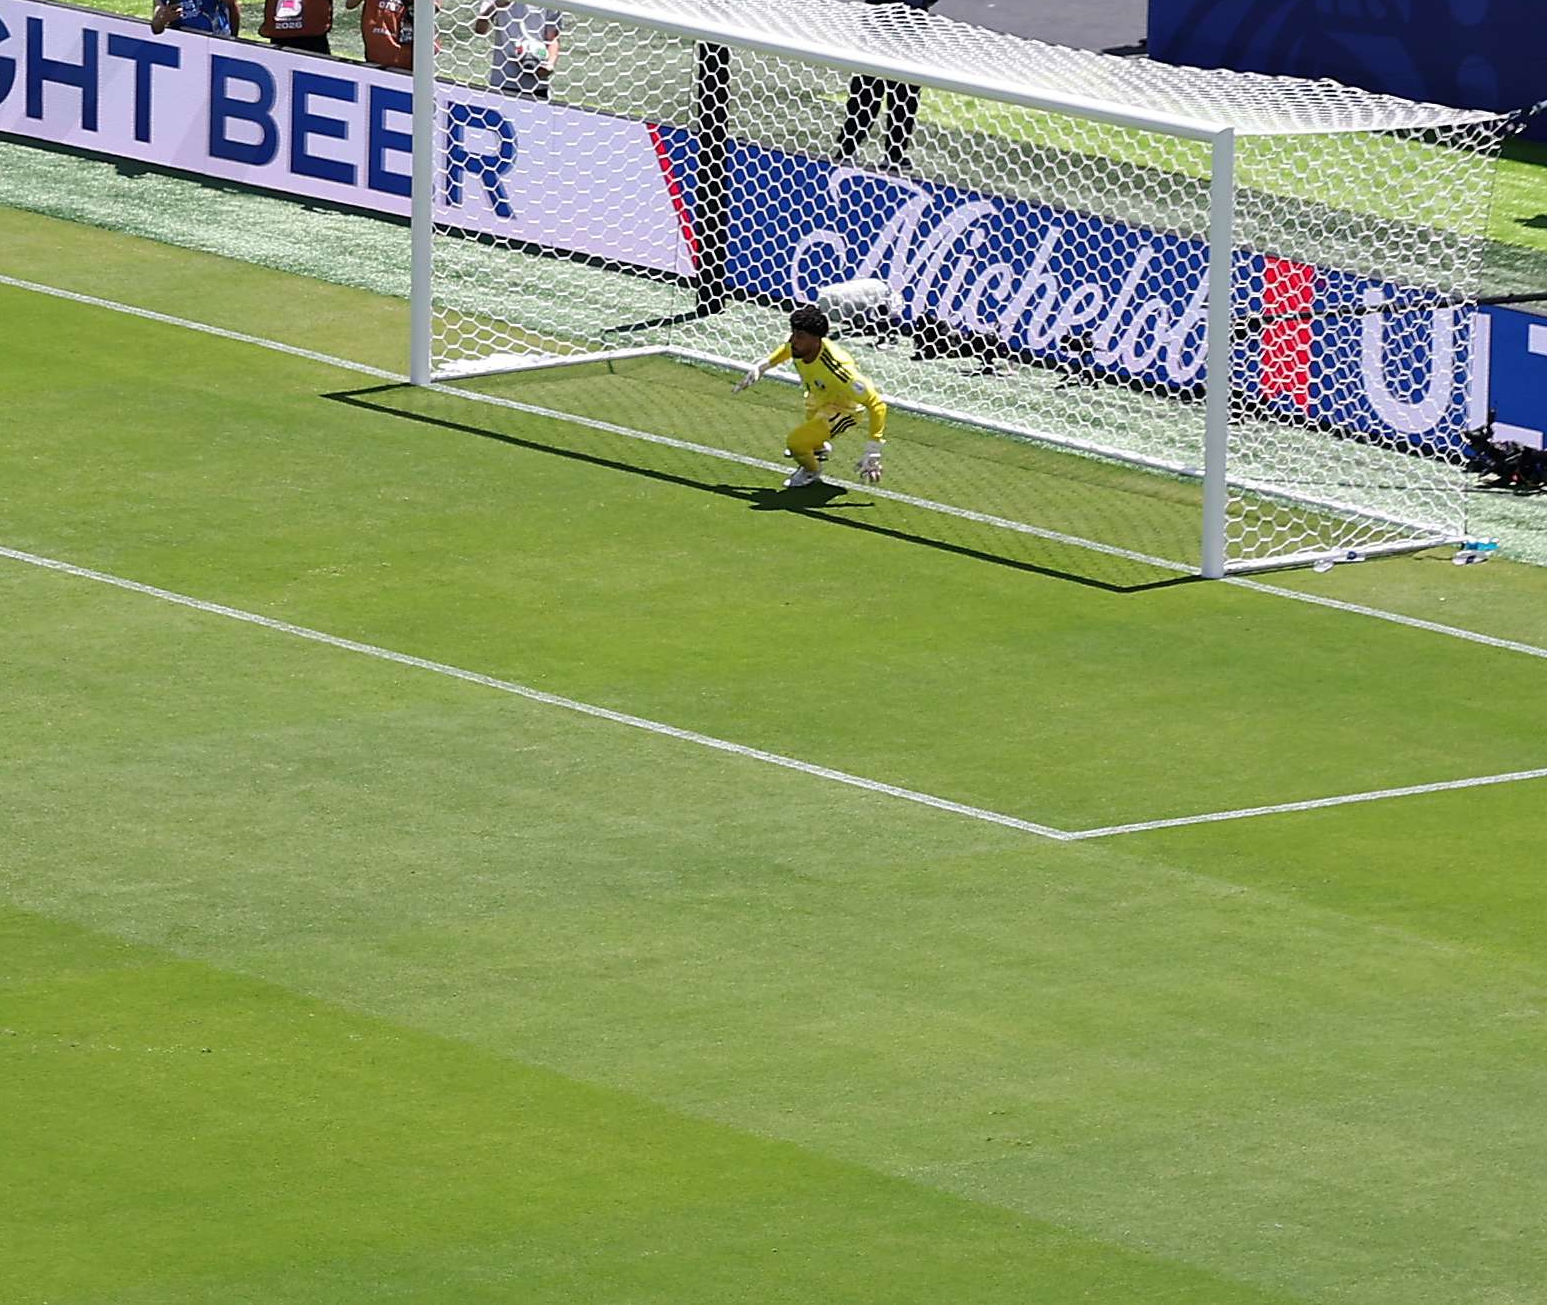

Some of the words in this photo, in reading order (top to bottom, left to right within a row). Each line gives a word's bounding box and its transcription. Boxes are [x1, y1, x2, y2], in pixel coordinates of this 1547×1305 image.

[274, 21, 303, 30] 2026
[209, 54, 518, 219] BEER
[791, 165, 1211, 385] Michelob
